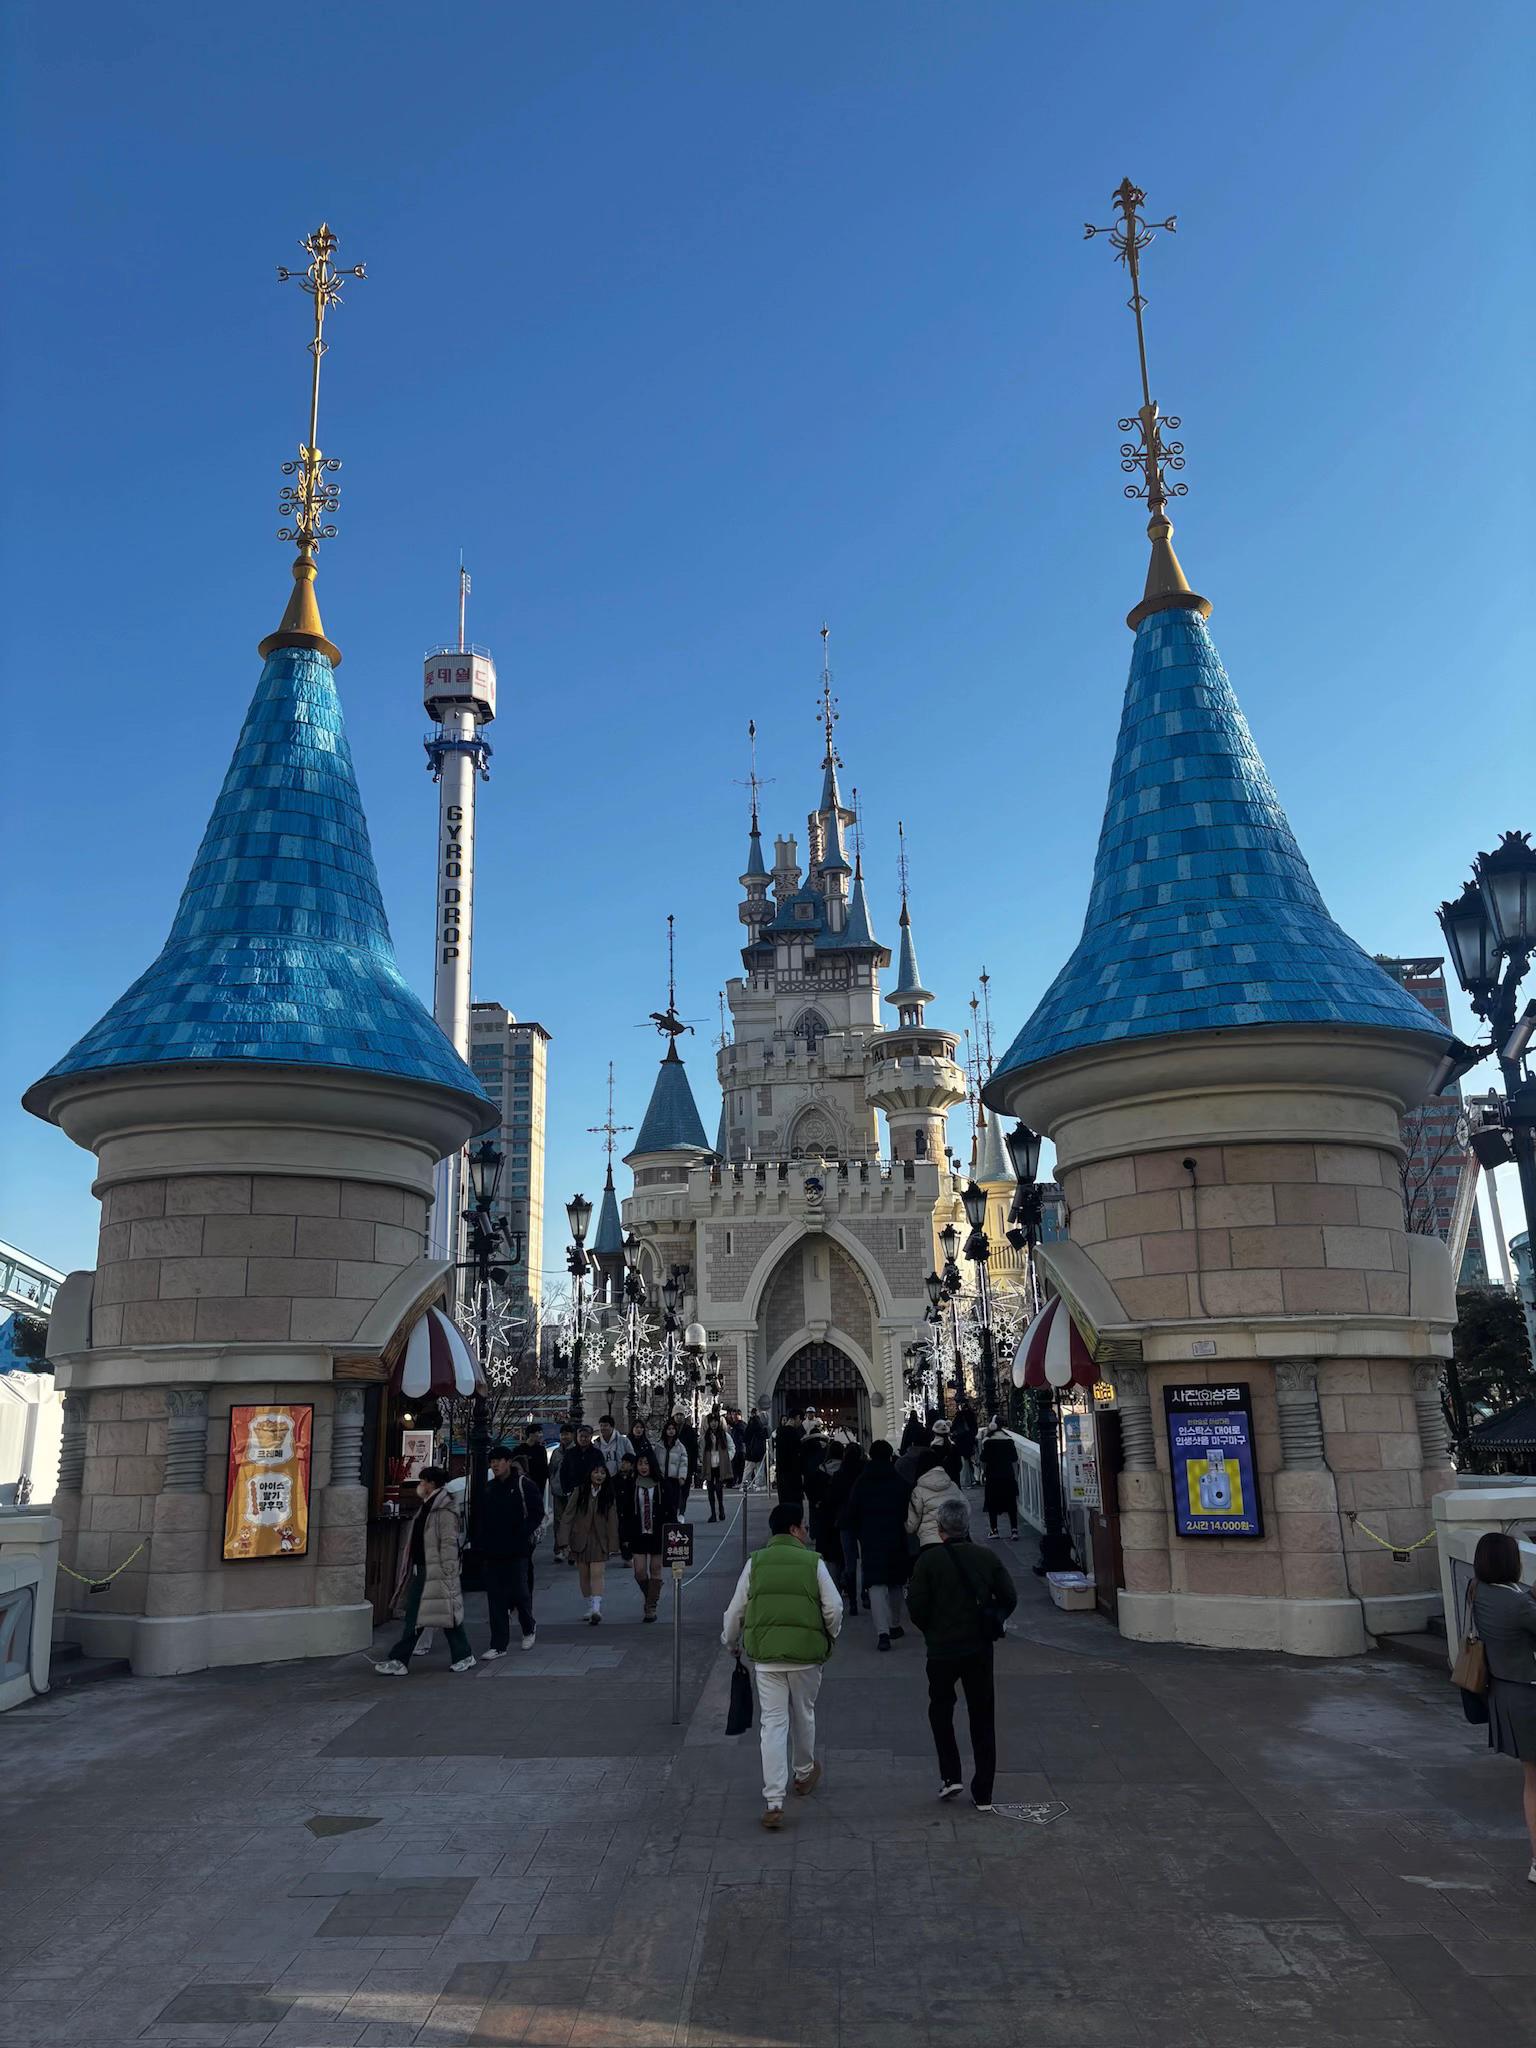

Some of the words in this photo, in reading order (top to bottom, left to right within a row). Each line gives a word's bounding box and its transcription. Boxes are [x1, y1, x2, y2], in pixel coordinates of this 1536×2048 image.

[425, 667, 488, 688] 롯데월드
[446, 805, 463, 878] GYRO
[443, 888, 461, 965] DROP
[1172, 1389, 1199, 1402] 사진
[1212, 1388, 1241, 1401] 상점
[1178, 1426, 1213, 1436] 인스탁스
[1214, 1425, 1241, 1435] 대여로
[1211, 1435, 1246, 1445] 마구마구
[259, 1482, 285, 1491] 아이스
[263, 1491, 280, 1501] 딸기
[1186, 1521, 1209, 1531] 2시간
